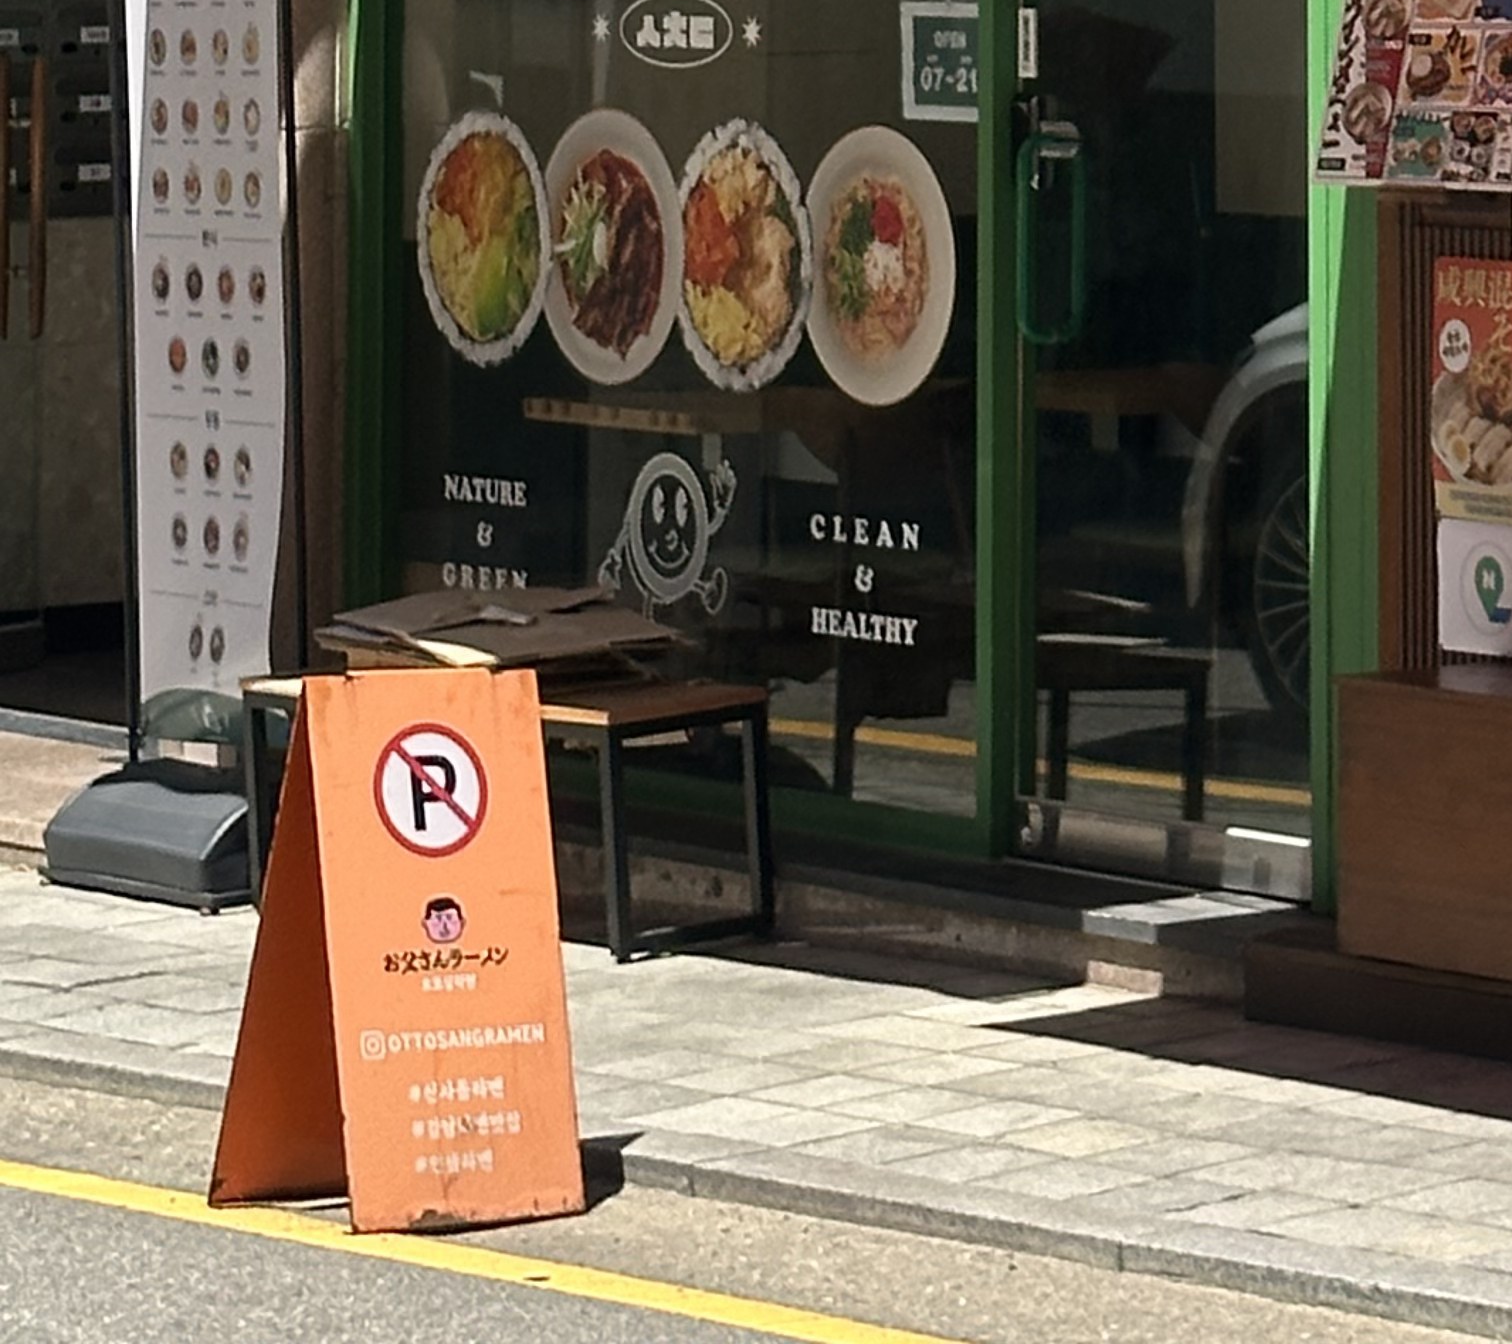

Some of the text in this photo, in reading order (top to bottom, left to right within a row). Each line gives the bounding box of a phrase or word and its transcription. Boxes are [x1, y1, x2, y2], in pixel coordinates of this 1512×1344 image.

[443, 475, 528, 508] NATURE
[475, 520, 494, 548] &
[810, 514, 921, 552] CLEAN
[853, 565, 876, 594] &
[811, 607, 919, 647] HEALTHY
[383, 946, 510, 975] お父さんラーメン
[387, 1023, 546, 1054] OTTOSANGRAMEN
